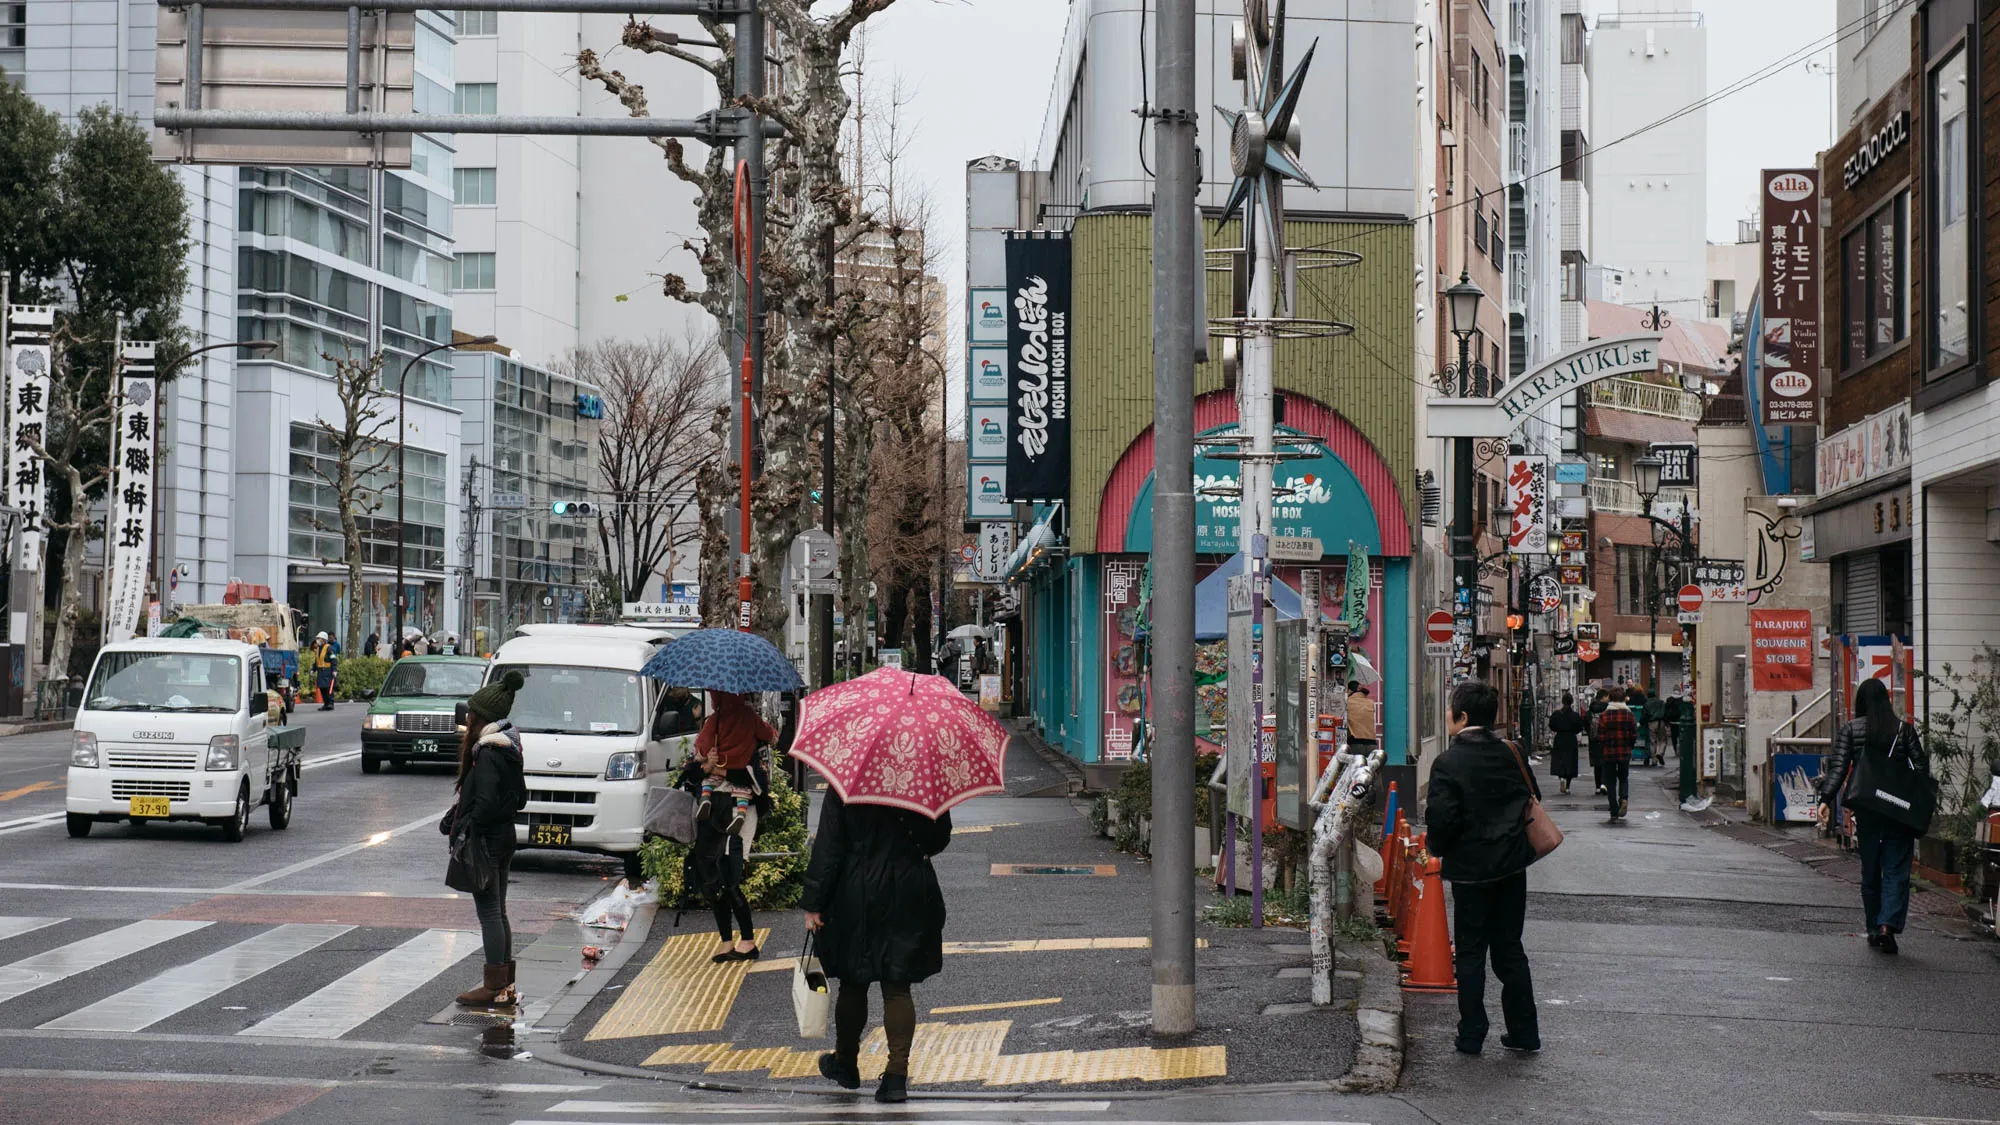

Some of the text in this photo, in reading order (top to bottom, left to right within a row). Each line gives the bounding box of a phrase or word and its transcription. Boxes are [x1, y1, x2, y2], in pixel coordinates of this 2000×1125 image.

[1774, 178, 1809, 191] alla
[1791, 209, 1812, 301] ハーモニー
[1771, 225, 1787, 310] 東京センター
[1794, 318, 1816, 326] Piano
[1793, 329, 1816, 337] Violin
[1795, 340, 1815, 349] Vocal
[1051, 312, 1066, 419] MOSHI MOSHI BOX
[1775, 375, 1807, 388] alla
[1798, 410, 1813, 419] 4F
[1655, 449, 1691, 465] STAY
[1530, 462, 1545, 525] 横浜家系
[1212, 506, 1302, 518] MOSH BOX
[989, 533, 999, 574] あしどり
[1695, 567, 1745, 581] 原宿通り
[1113, 575, 1126, 601] 原宿
[1711, 586, 1746, 600] 昭和
[634, 605, 673, 614] 株式会社
[1755, 620, 1807, 631] HARAJUKU
[1755, 638, 1807, 648] SOUVENIR
[1766, 654, 1797, 664] STORE
[132, 730, 175, 740] SUZUKI
[138, 804, 168, 816] 37-90
[537, 832, 569, 845] 53-47
